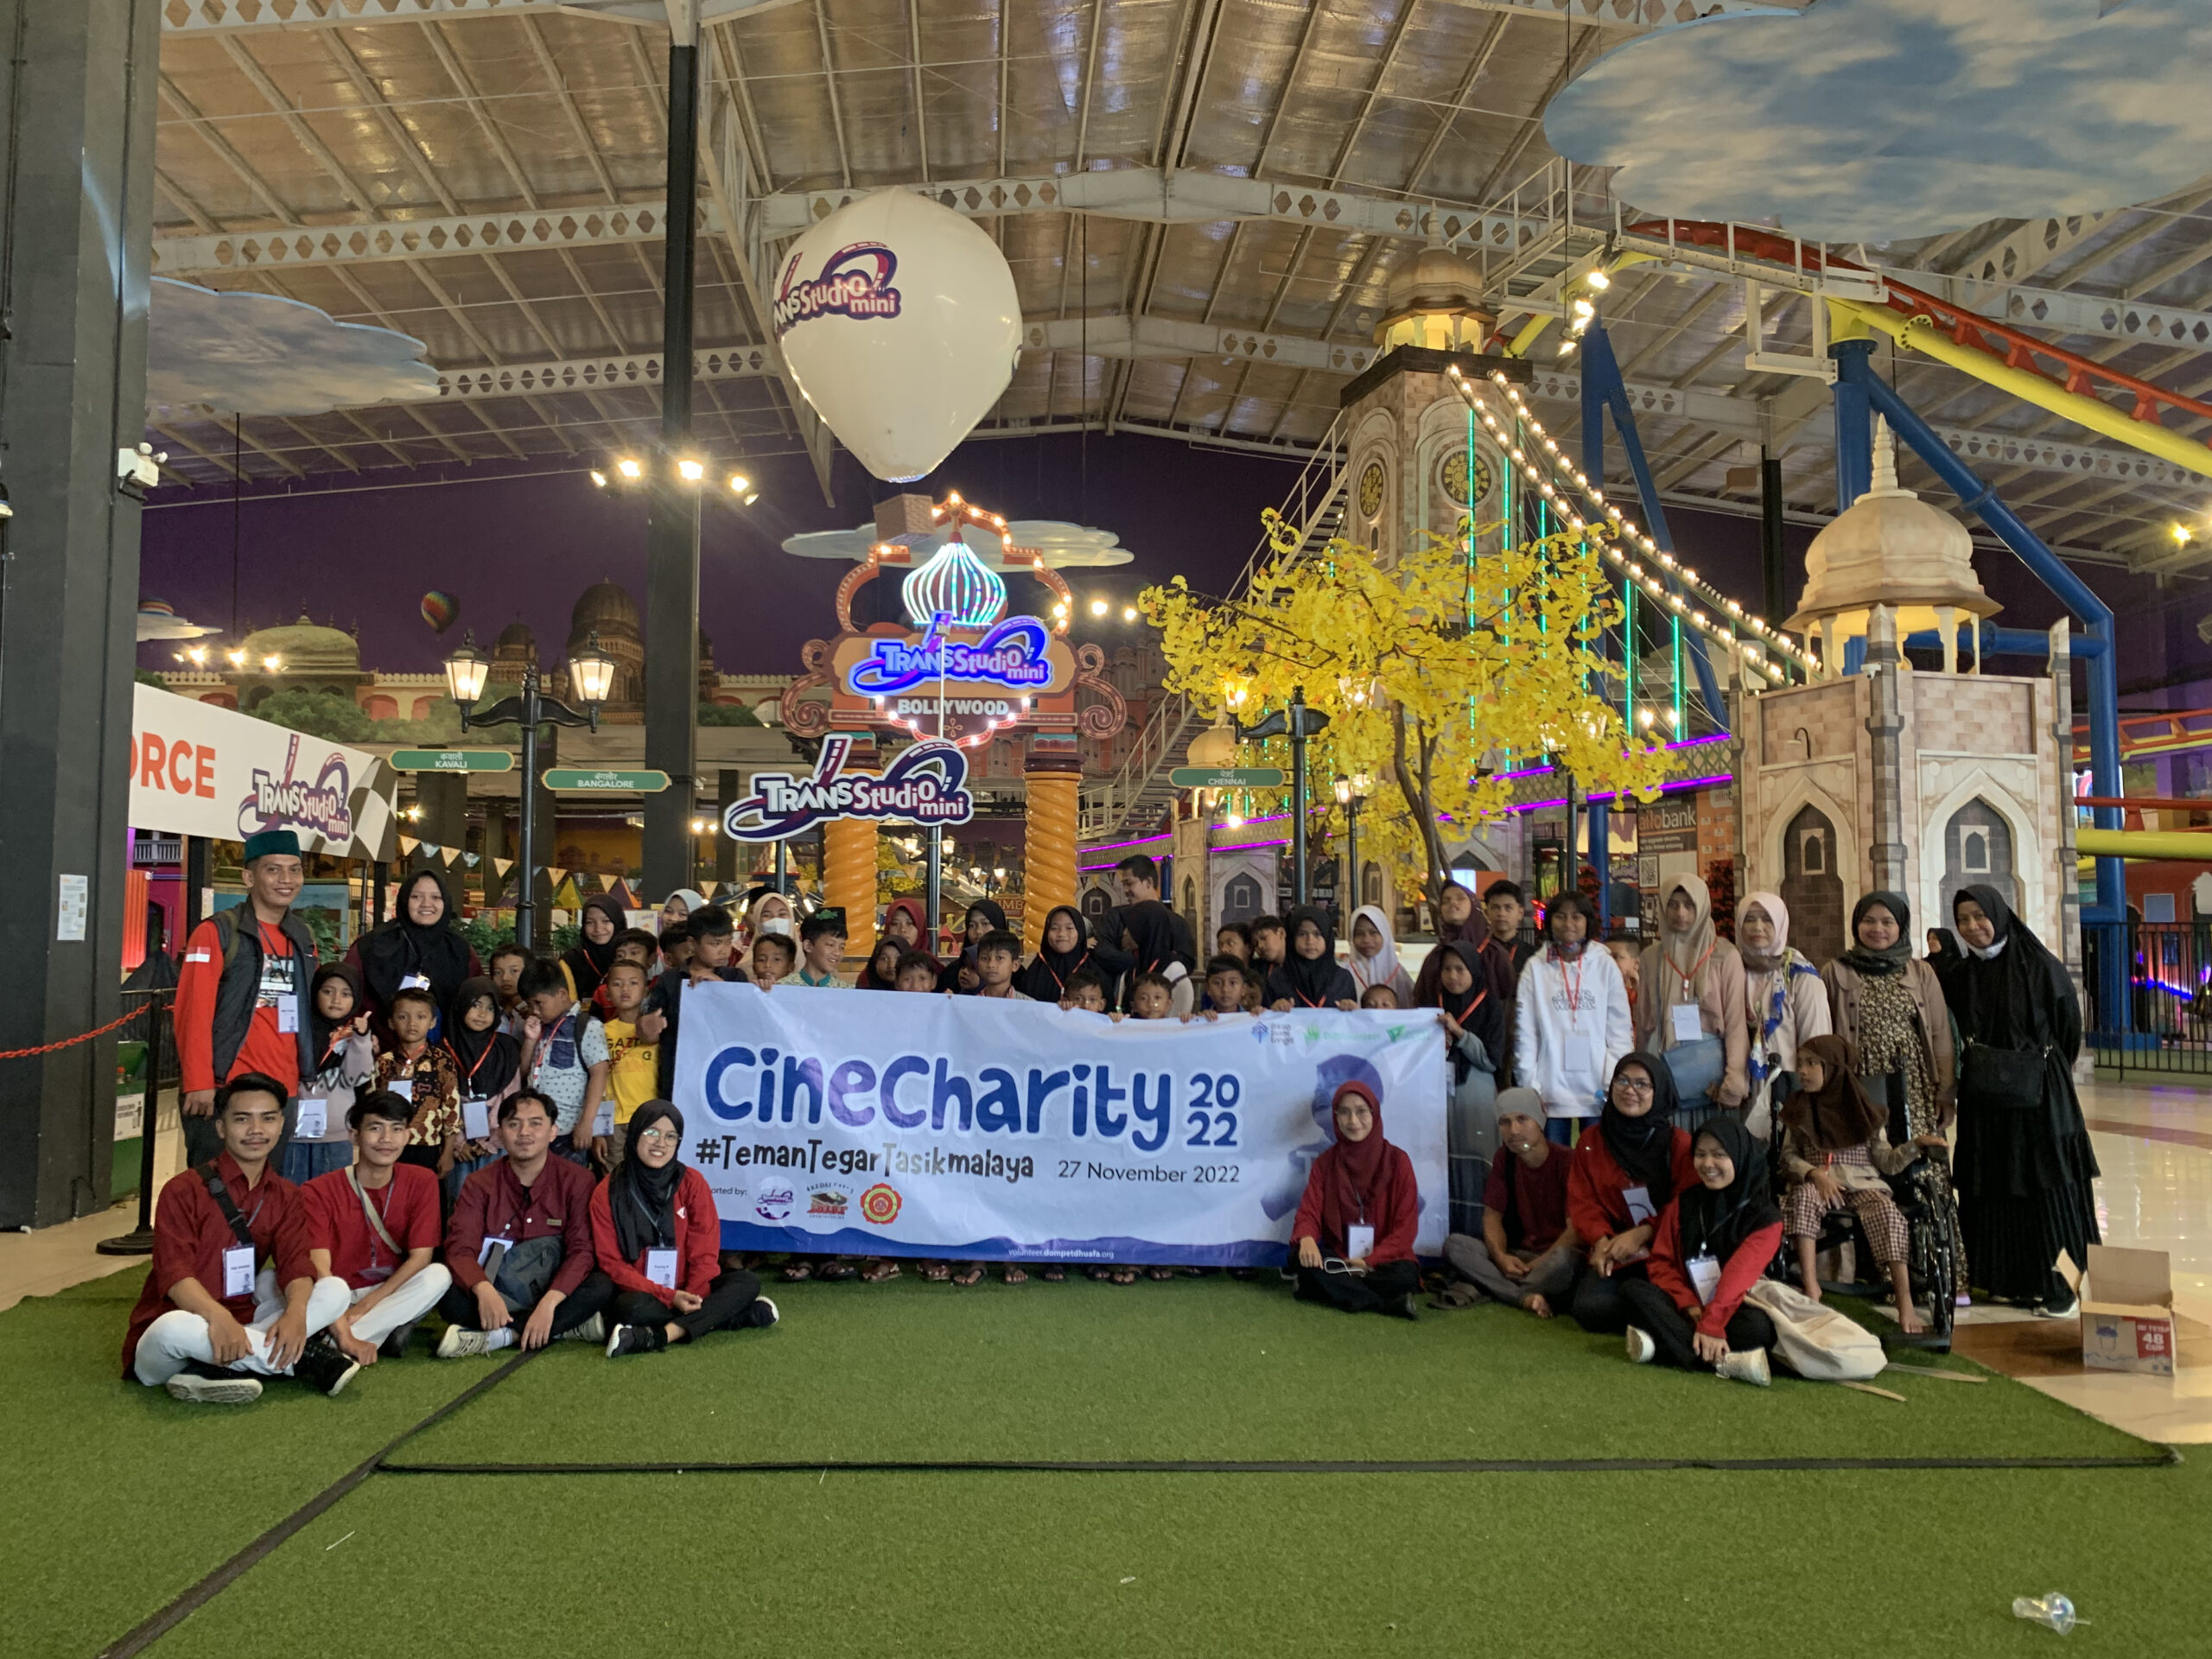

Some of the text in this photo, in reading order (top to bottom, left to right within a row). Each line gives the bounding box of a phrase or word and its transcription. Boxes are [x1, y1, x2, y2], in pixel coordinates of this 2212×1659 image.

[850, 292, 895, 313] mini
[1007, 664, 1045, 679] mini
[897, 698, 1009, 715] BOLLYWOOD
[577, 779, 634, 788] BANGALORE
[918, 798, 964, 816] mini
[328, 814, 348, 835] mini
[705, 1046, 1171, 1151] CineCharity
[1188, 1073, 1240, 1108] 20
[1186, 1111, 1238, 1147] 22
[695, 1135, 1033, 1183] #TemanTegarTasikmalaya
[1058, 1160, 1240, 1183] 27 November 2022
[1007, 1248, 1115, 1260] volunteer.dompetdhuafa.org
[2143, 1332, 2164, 1344] 48
